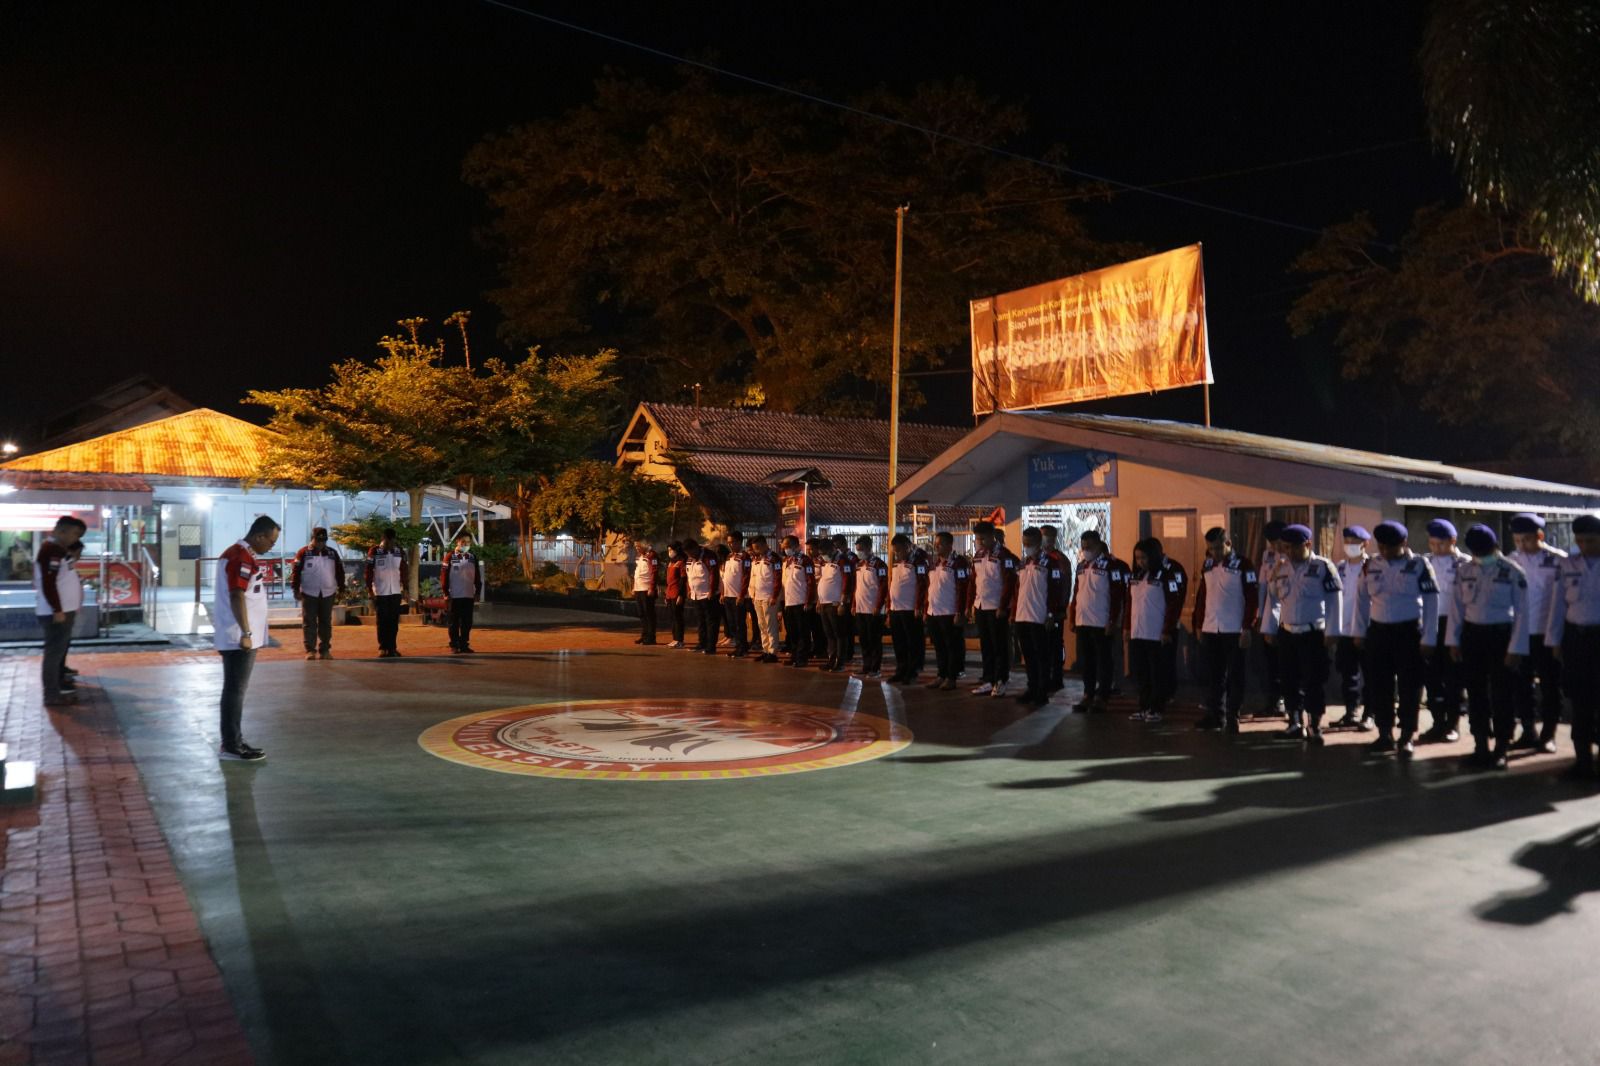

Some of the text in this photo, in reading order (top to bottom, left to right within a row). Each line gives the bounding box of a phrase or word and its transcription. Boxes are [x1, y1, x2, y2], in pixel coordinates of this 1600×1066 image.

[1009, 320, 1027, 330] Siap
[1028, 312, 1055, 326] Meaih
[1032, 457, 1055, 472] Yuk
[458, 719, 655, 771] UNIVERSITY
[527, 736, 603, 754] PASTI
